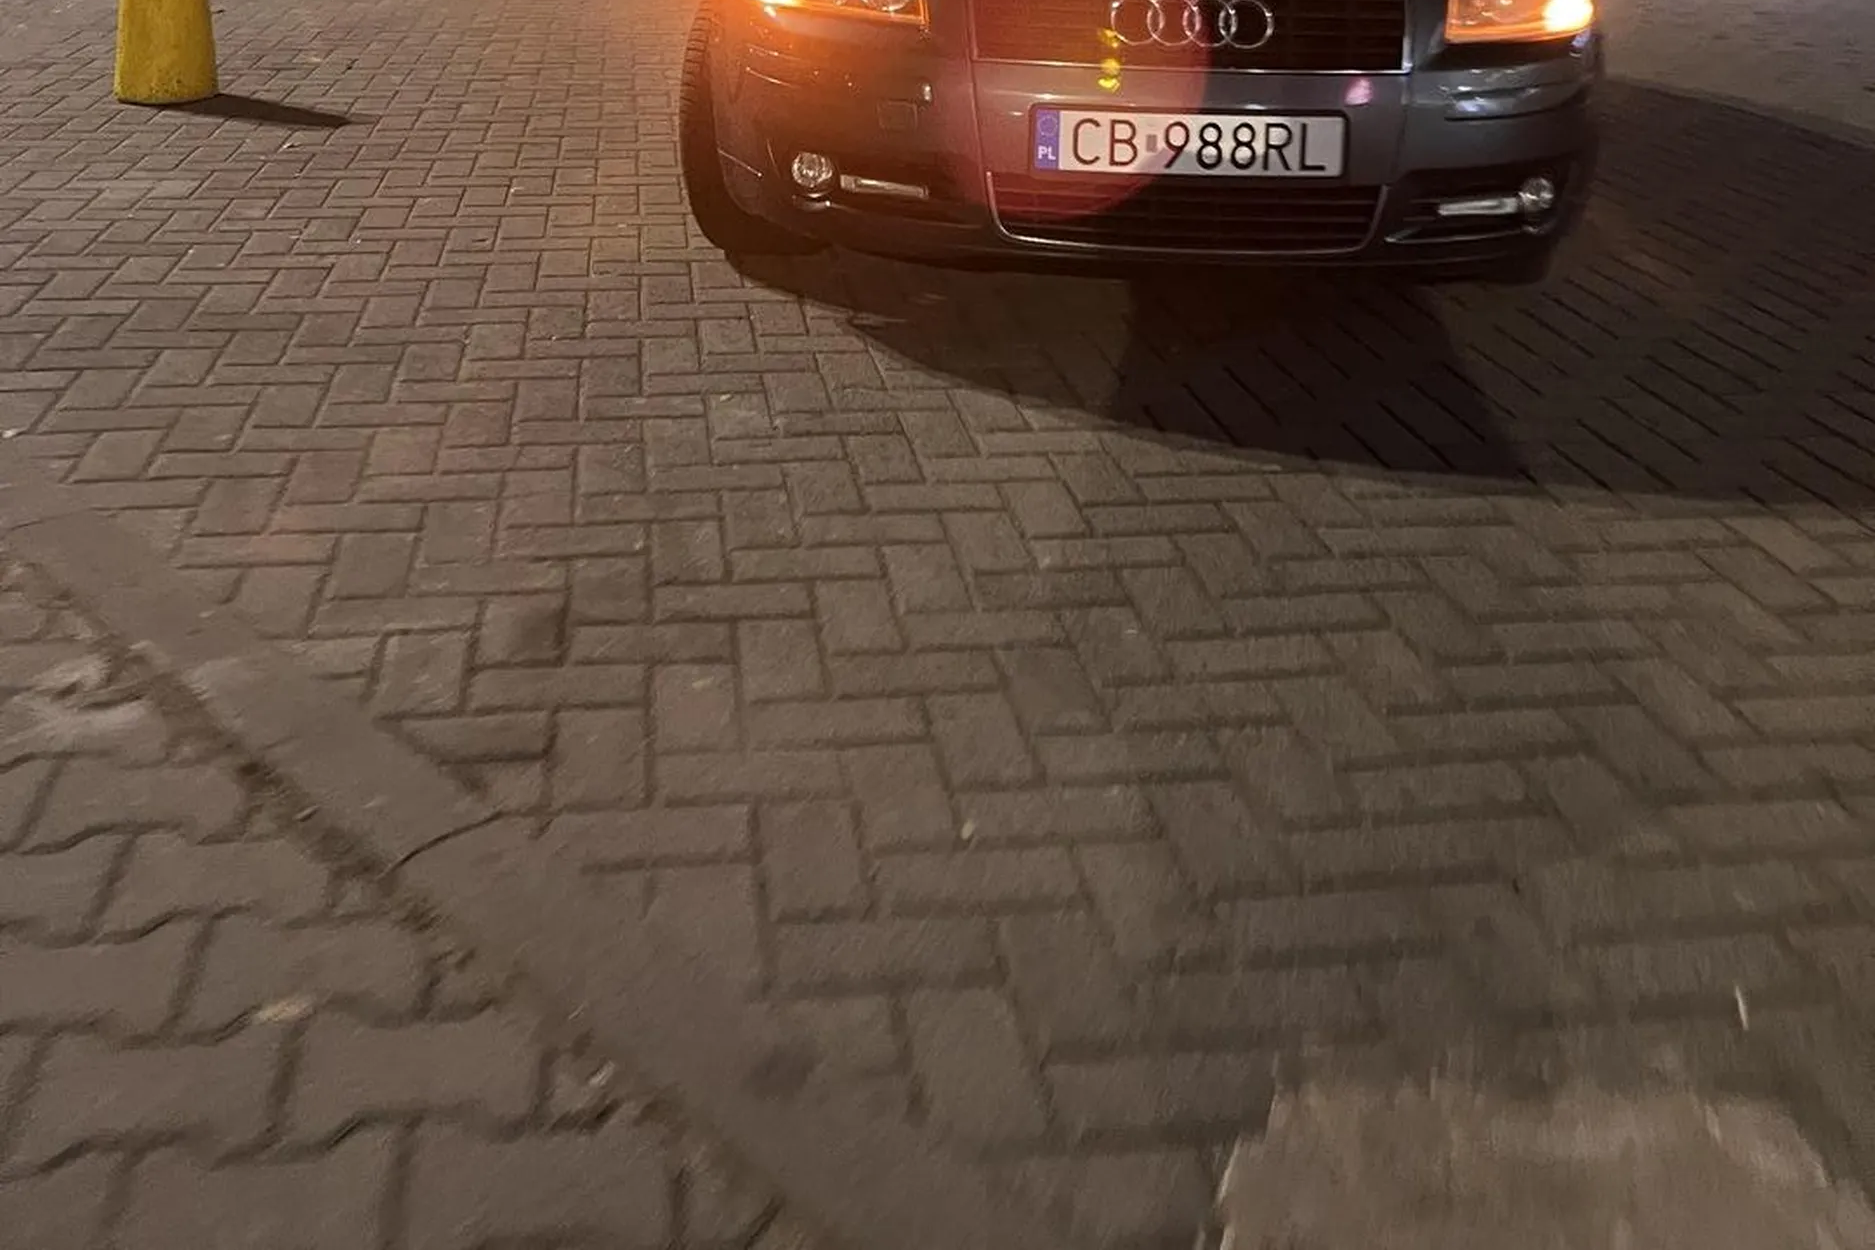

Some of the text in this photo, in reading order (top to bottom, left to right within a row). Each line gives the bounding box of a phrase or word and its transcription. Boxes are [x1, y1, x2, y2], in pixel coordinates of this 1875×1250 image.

[1037, 145, 1056, 161] PL
[1072, 118, 1327, 172] CB 988RL
